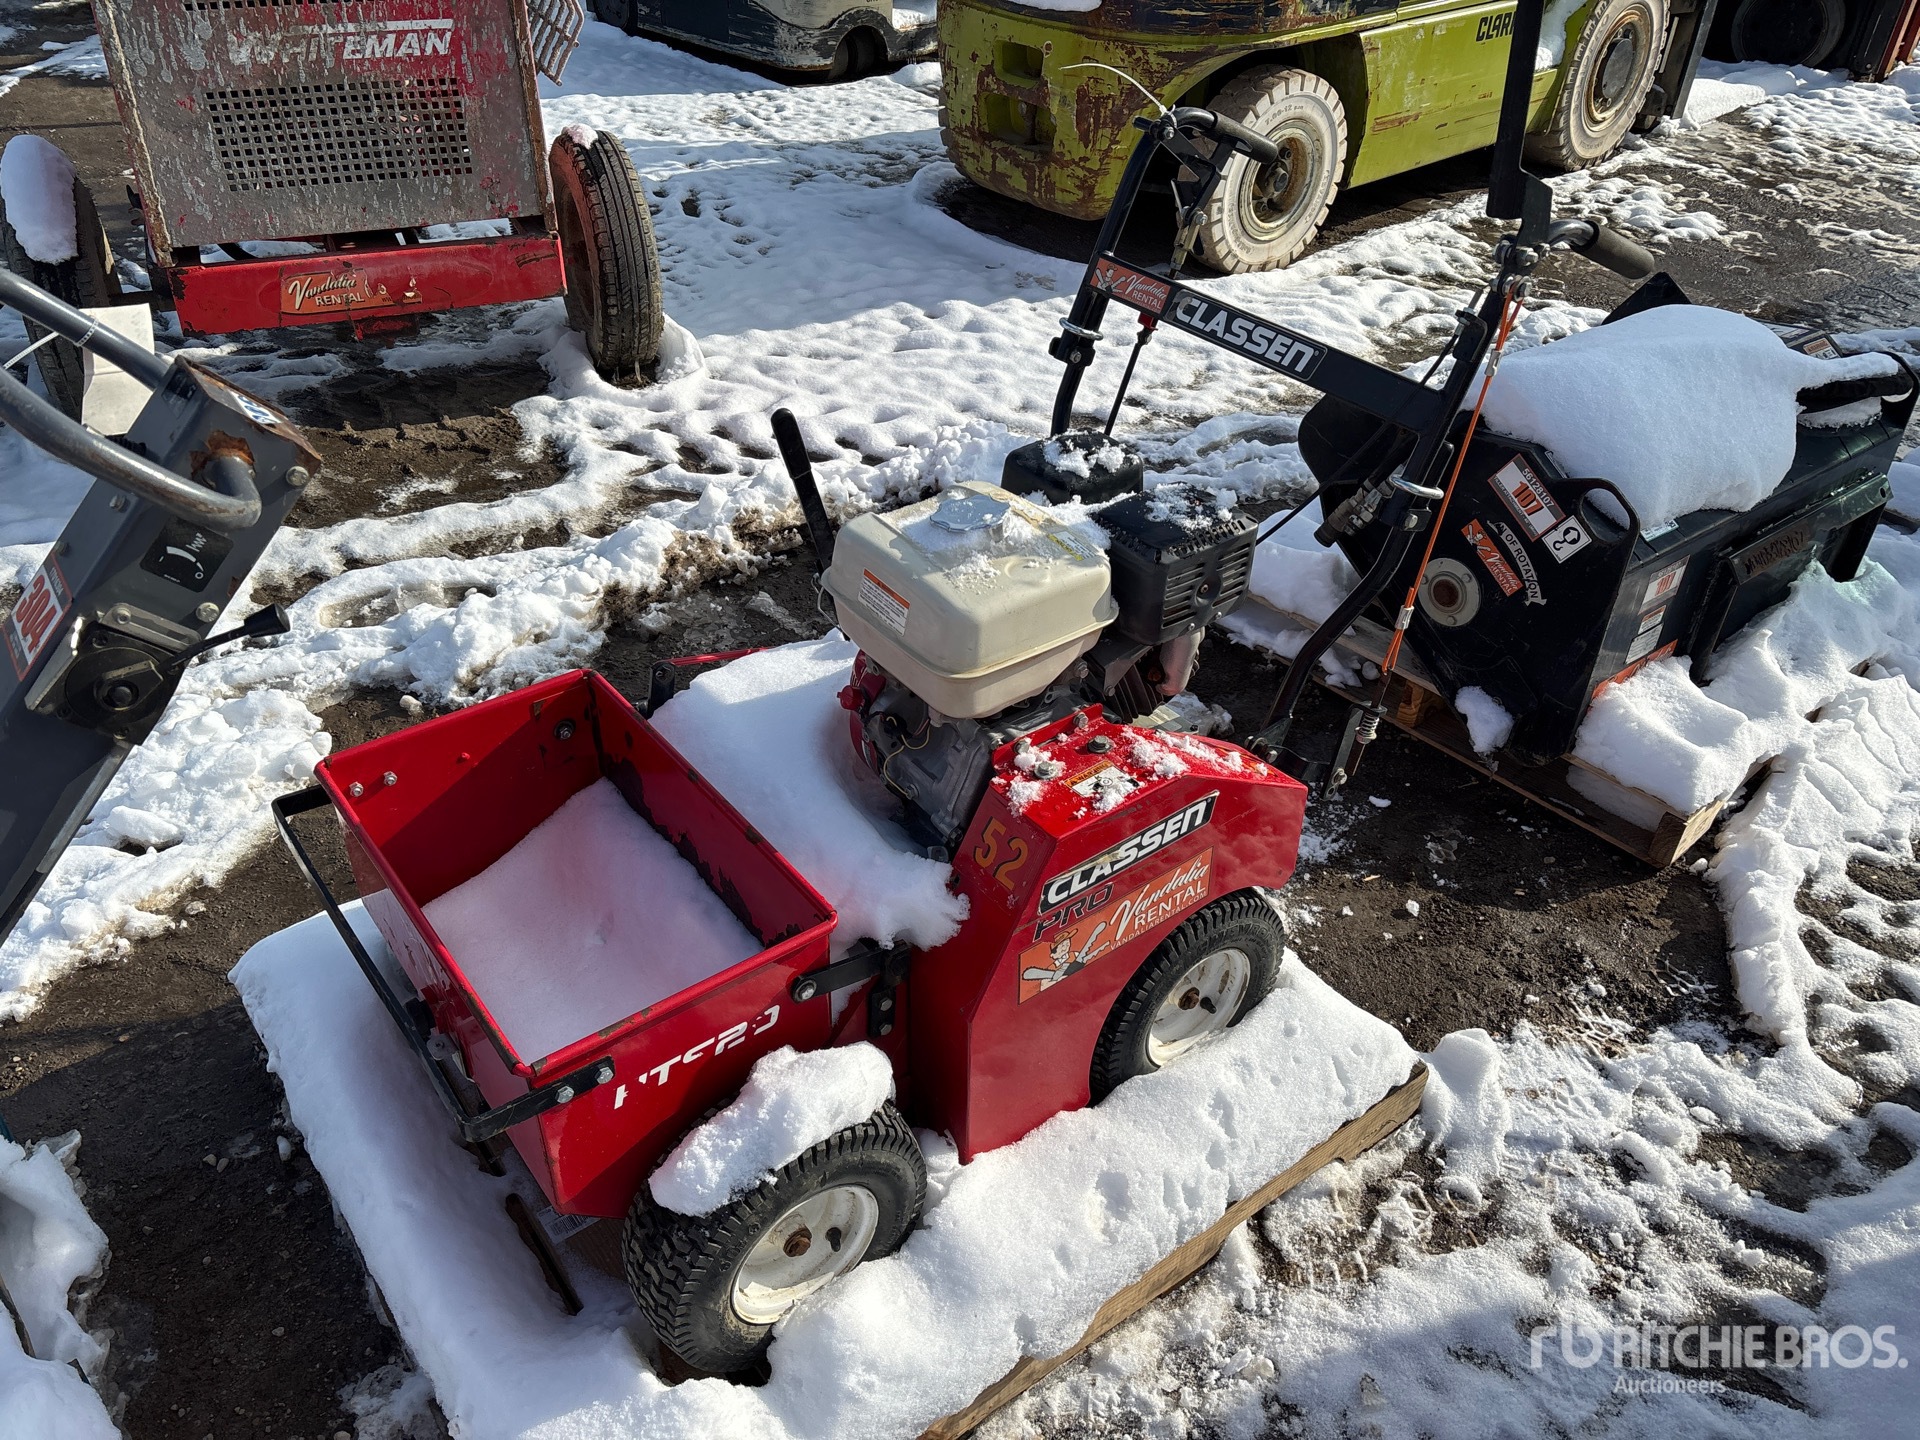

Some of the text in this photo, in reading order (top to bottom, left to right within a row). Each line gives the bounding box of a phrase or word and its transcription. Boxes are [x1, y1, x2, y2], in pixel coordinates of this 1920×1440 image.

[288, 274, 357, 310] Vandalia
[315, 292, 365, 307] RENTAL
[1125, 274, 1168, 300] Vandalia
[1132, 290, 1161, 309] RENTAL
[1175, 296, 1315, 373] CLASSEN
[1511, 480, 1545, 516] 107
[1521, 468, 1555, 508] 56128107
[1487, 552, 1518, 591] Vandalia
[1490, 564, 1513, 594] RENTAL
[1505, 533, 1518, 547] OF
[1514, 548, 1539, 598] ROTATON
[15, 574, 57, 654] 304
[973, 815, 1029, 892] 52
[1047, 800, 1209, 904] CLASSEN
[1033, 882, 1114, 942] PRO
[1109, 855, 1210, 941] Vandalia
[1110, 891, 1207, 951] VANDALIARENTAL.COM
[1134, 881, 1206, 930] RENTAL
